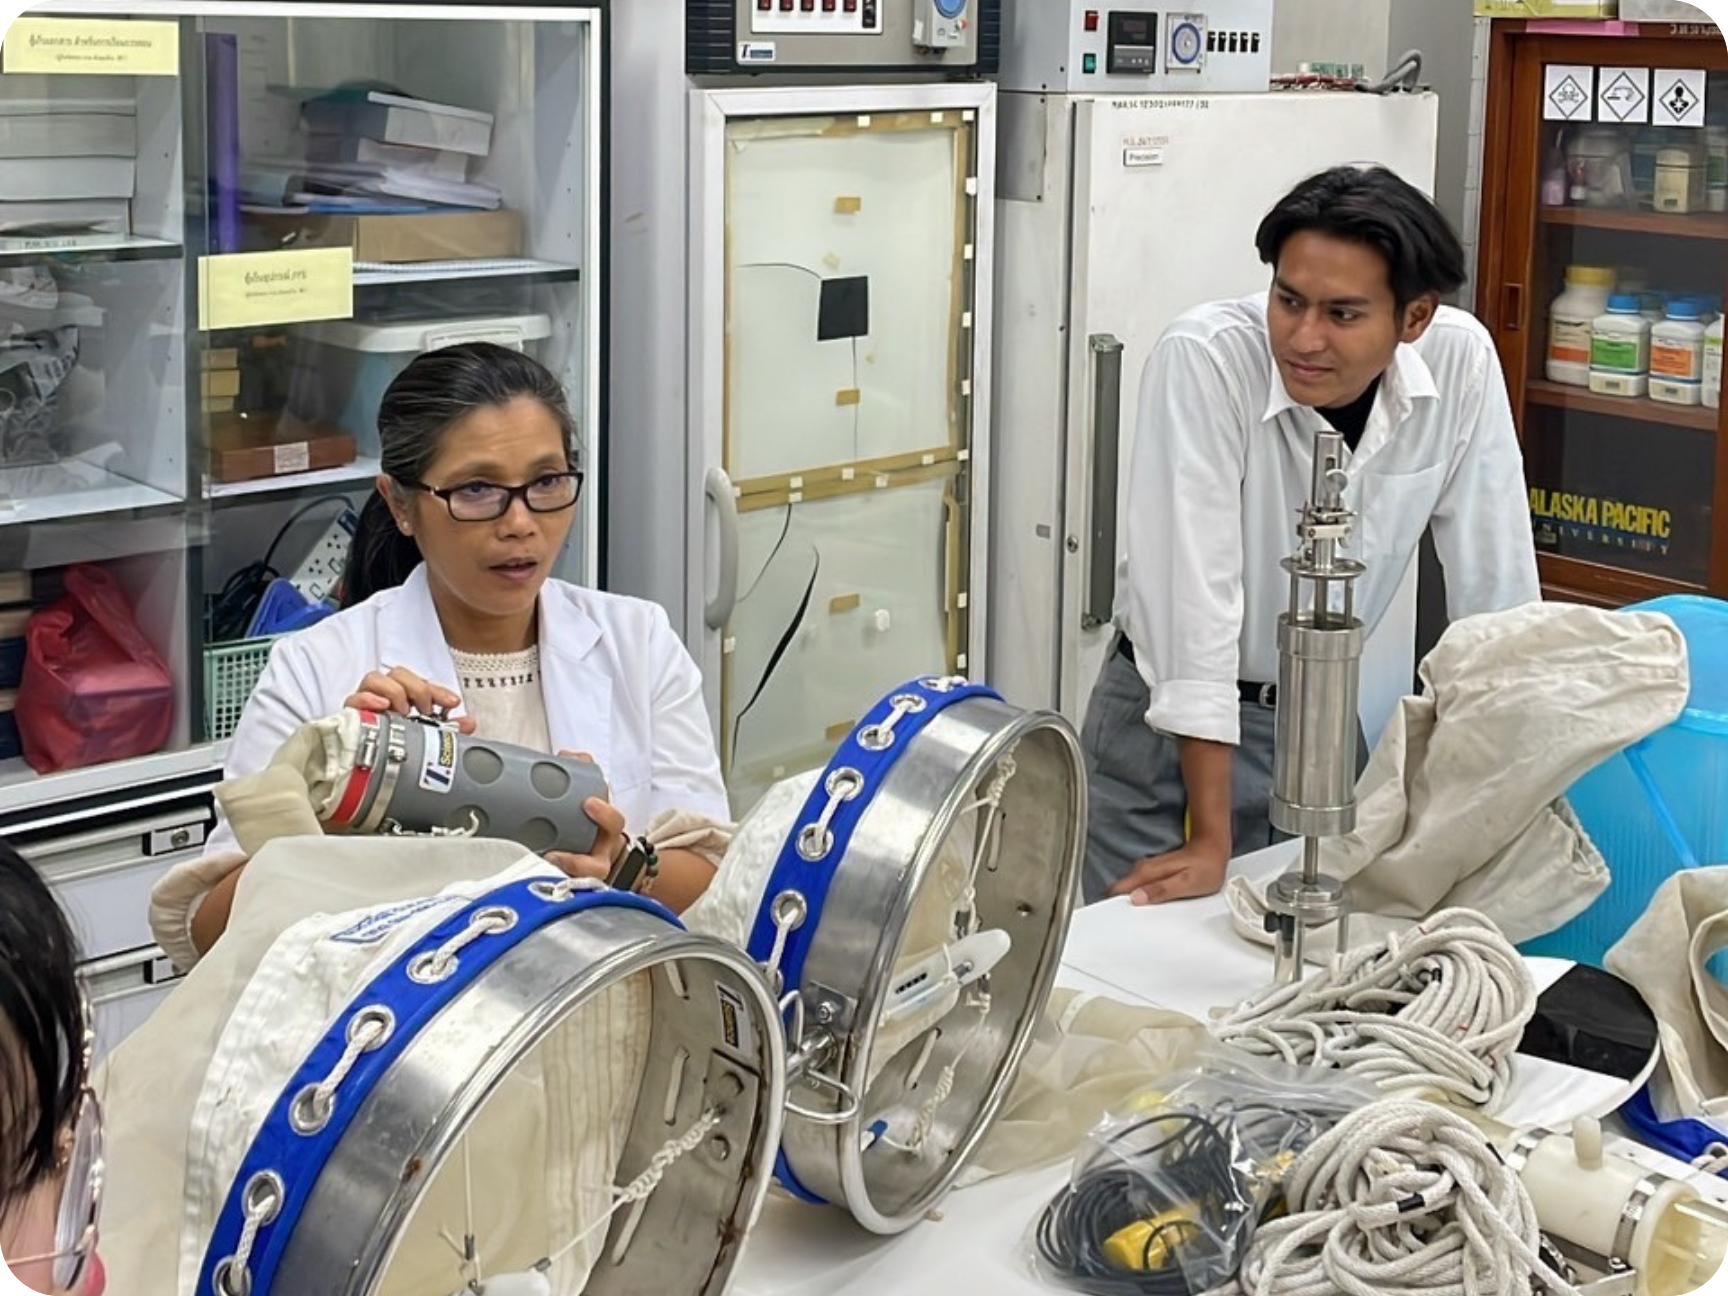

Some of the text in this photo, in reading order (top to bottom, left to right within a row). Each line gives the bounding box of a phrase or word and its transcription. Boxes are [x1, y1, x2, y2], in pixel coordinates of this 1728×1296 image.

[1129, 152, 1159, 162] Precision
[1530, 487, 1671, 539] ALASKA PACIFIC
[1535, 520, 1668, 555] NIVERSITY
